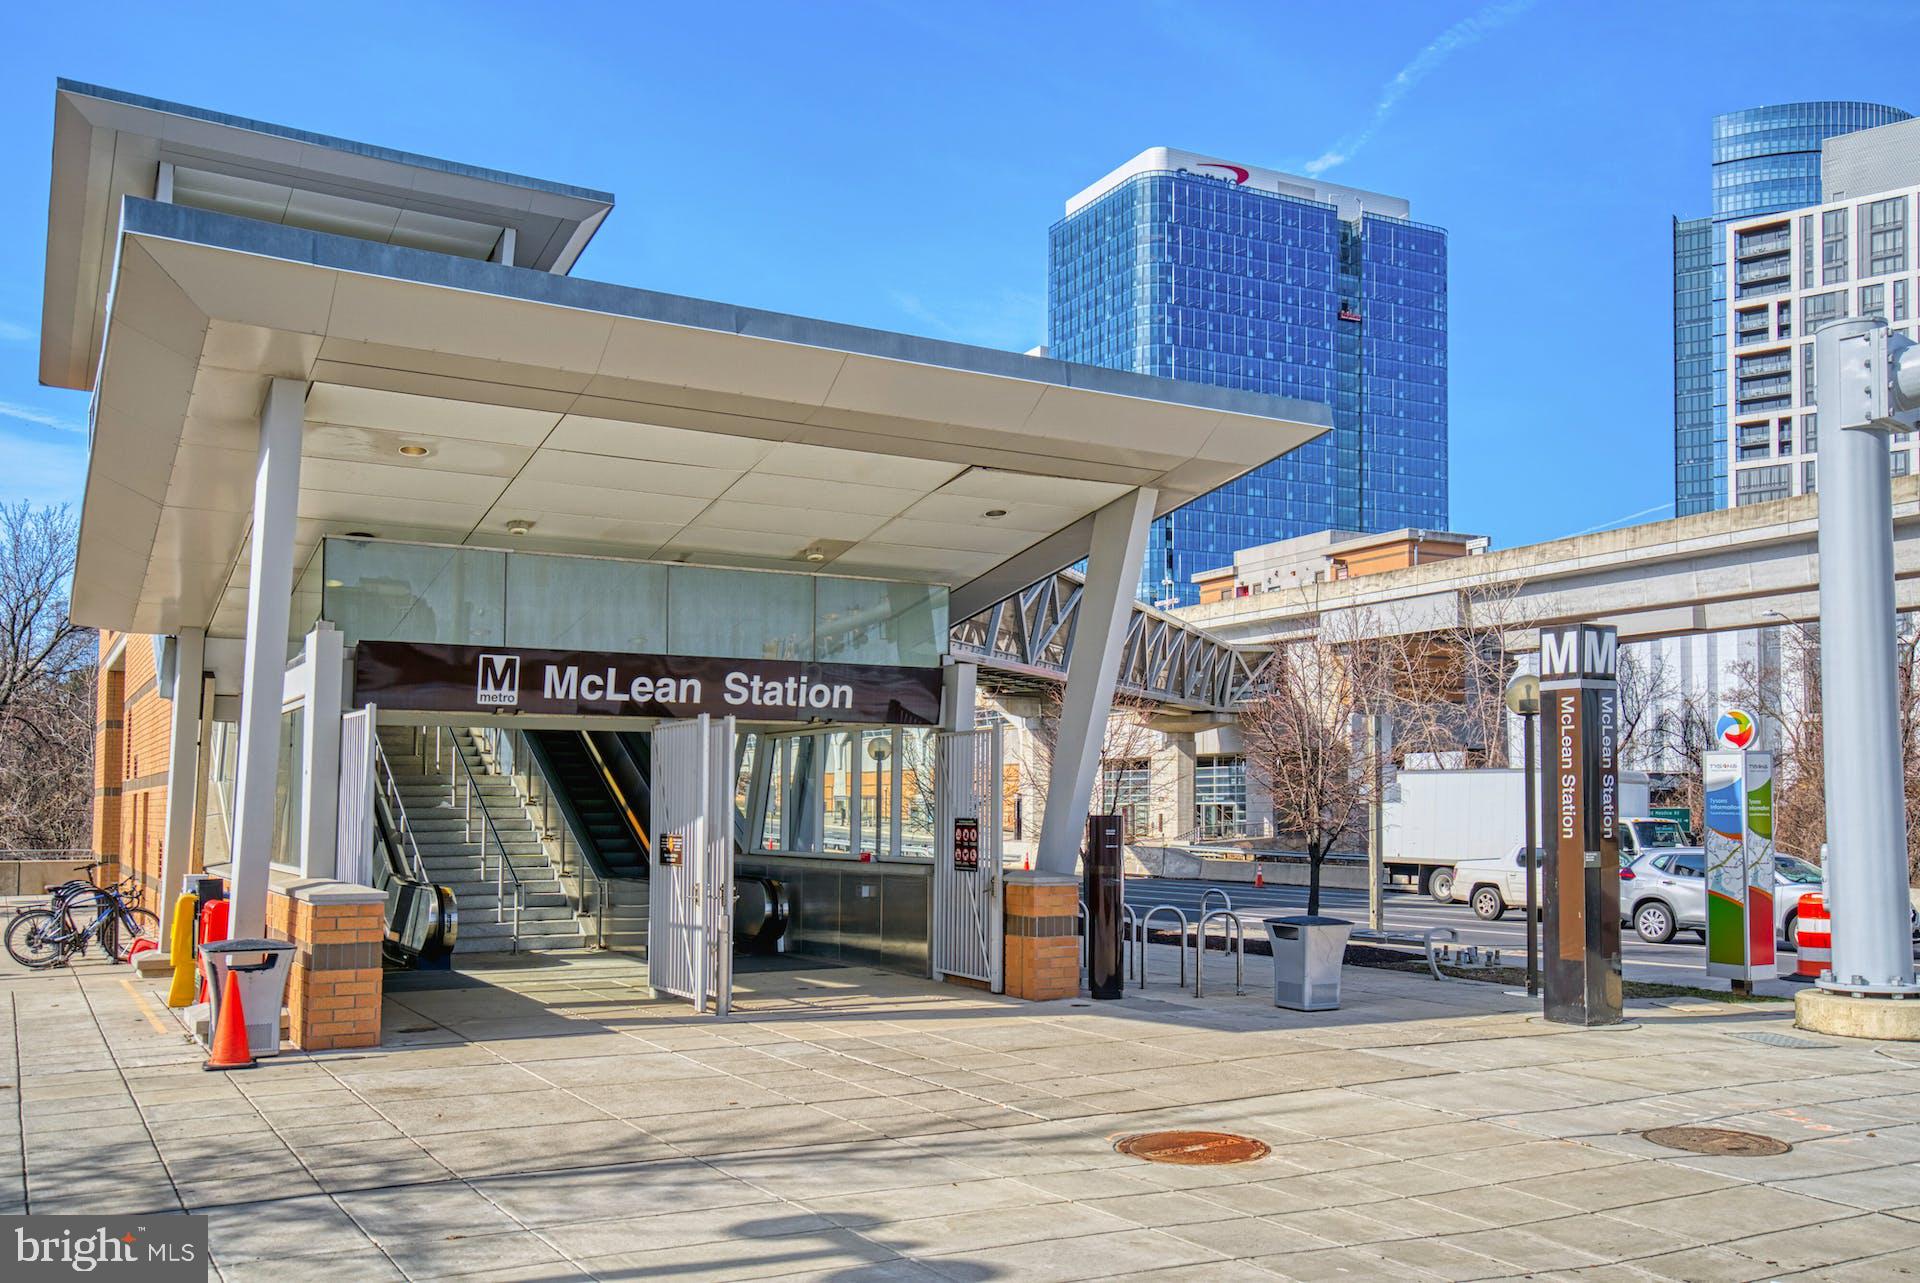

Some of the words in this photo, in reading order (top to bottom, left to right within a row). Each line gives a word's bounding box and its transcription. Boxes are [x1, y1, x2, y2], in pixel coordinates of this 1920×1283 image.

[480, 657, 518, 691] M
[1542, 631, 1577, 675] M
[1584, 631, 1616, 674] M
[480, 692, 515, 703] metro
[543, 665, 701, 704] McLean
[723, 672, 853, 709] Station
[1561, 696, 1575, 769] McLean
[1601, 696, 1613, 769] McLean
[1561, 774, 1576, 838] Station
[1602, 774, 1615, 839] Station
